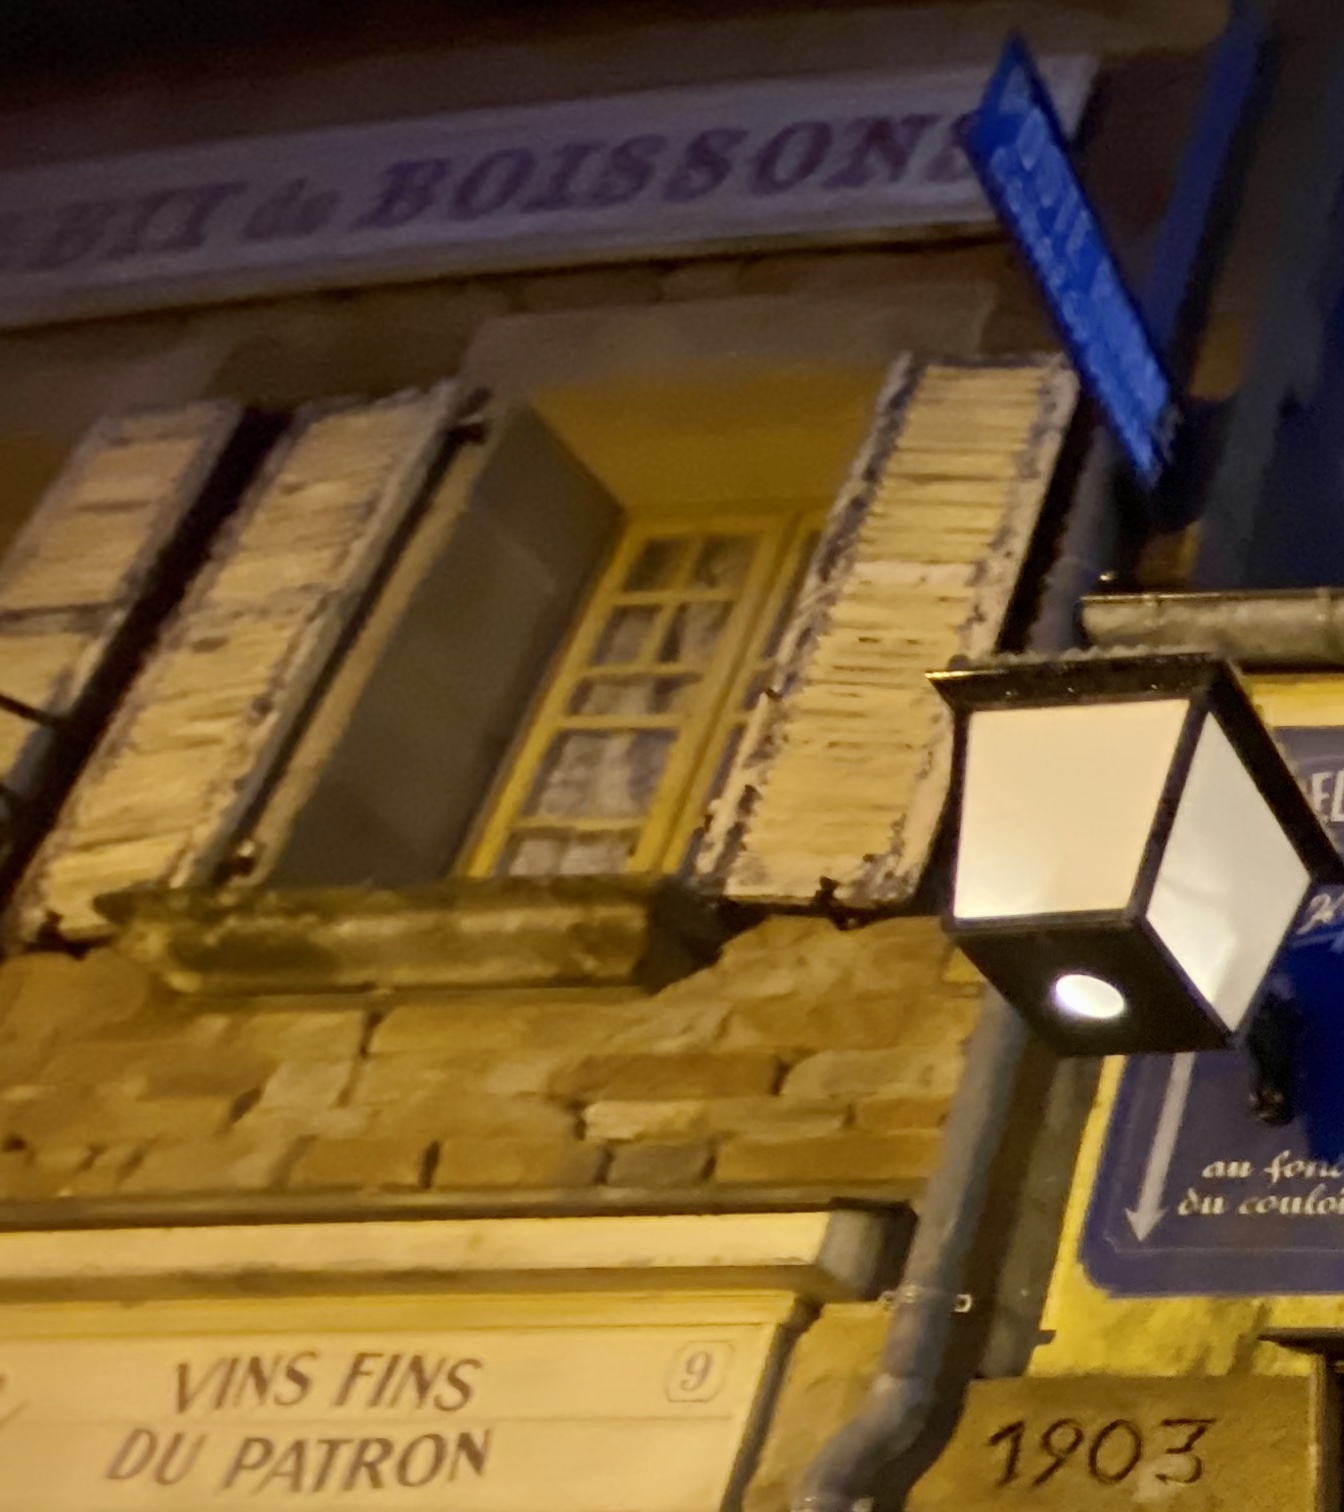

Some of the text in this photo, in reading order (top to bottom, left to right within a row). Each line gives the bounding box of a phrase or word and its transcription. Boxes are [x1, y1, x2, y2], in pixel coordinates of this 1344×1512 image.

[1202, 1160, 1252, 1179] au
[1178, 1187, 1225, 1216] du
[172, 1351, 484, 1413] VINS FINS
[678, 1350, 714, 1392] 9
[103, 1426, 494, 1493] DU PATRON
[985, 1416, 1217, 1490] 1903
